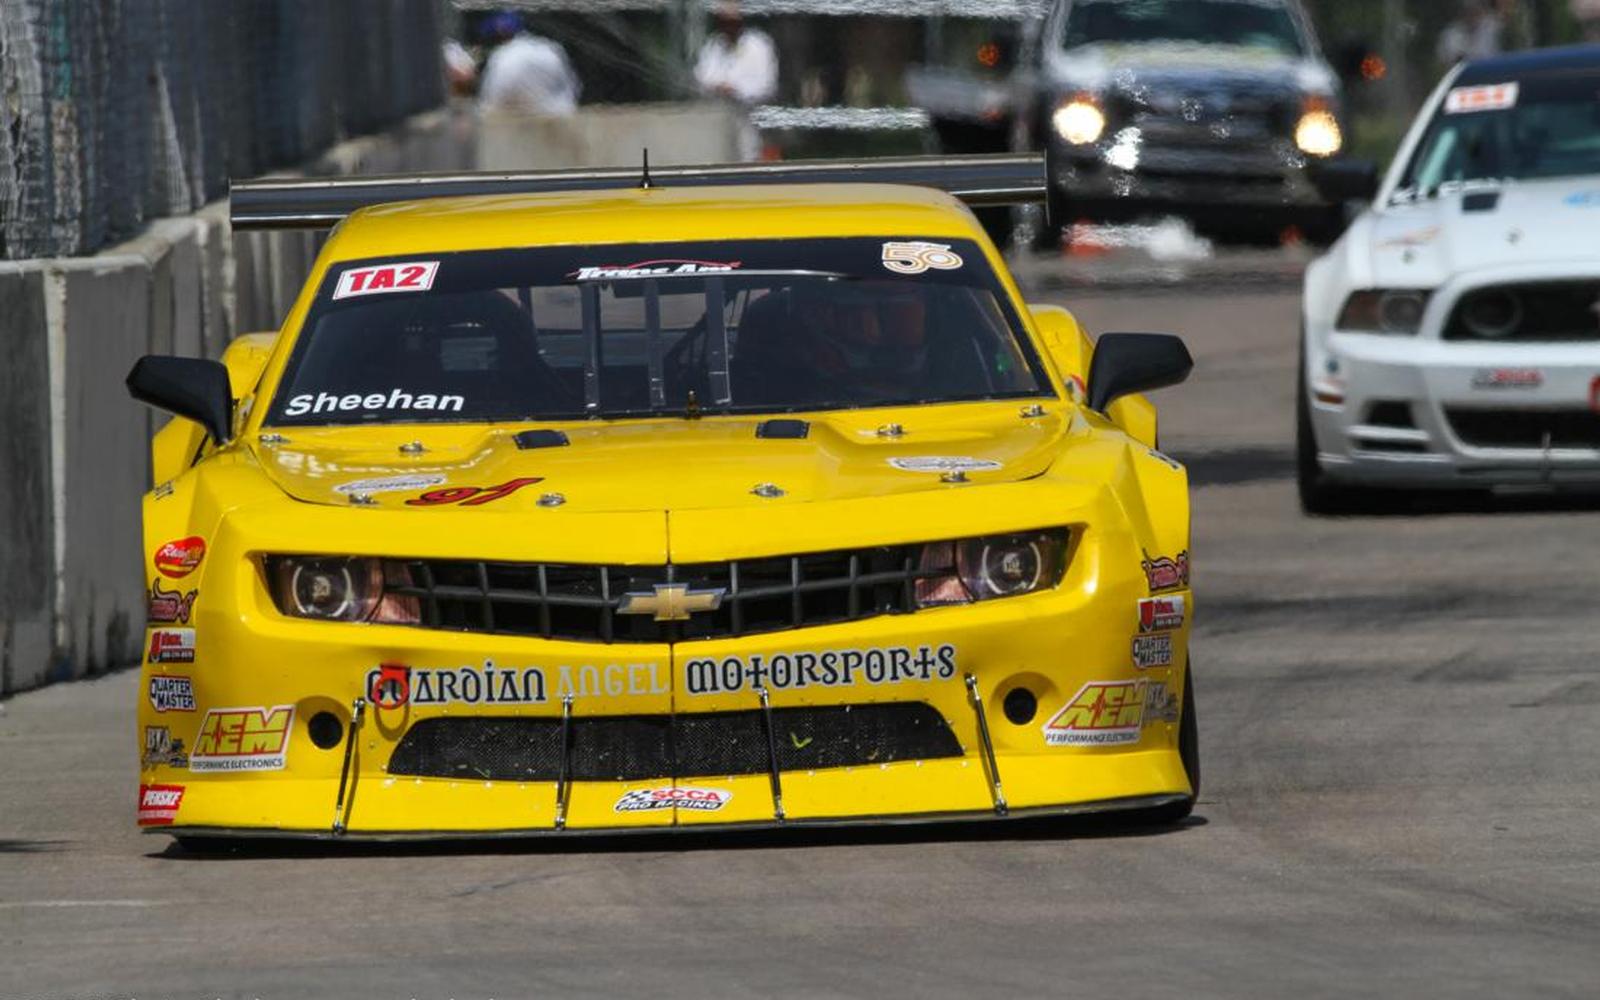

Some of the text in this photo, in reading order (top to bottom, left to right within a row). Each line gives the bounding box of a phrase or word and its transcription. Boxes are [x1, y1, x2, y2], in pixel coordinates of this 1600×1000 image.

[882, 241, 963, 274] 50
[349, 266, 426, 292] TA2
[284, 388, 465, 416] Sheehan
[558, 663, 669, 697] ANGEL
[1047, 685, 1146, 729] AEM
[192, 709, 292, 756] AEM
[651, 788, 720, 801] SCCA
[655, 799, 719, 809] RACING
